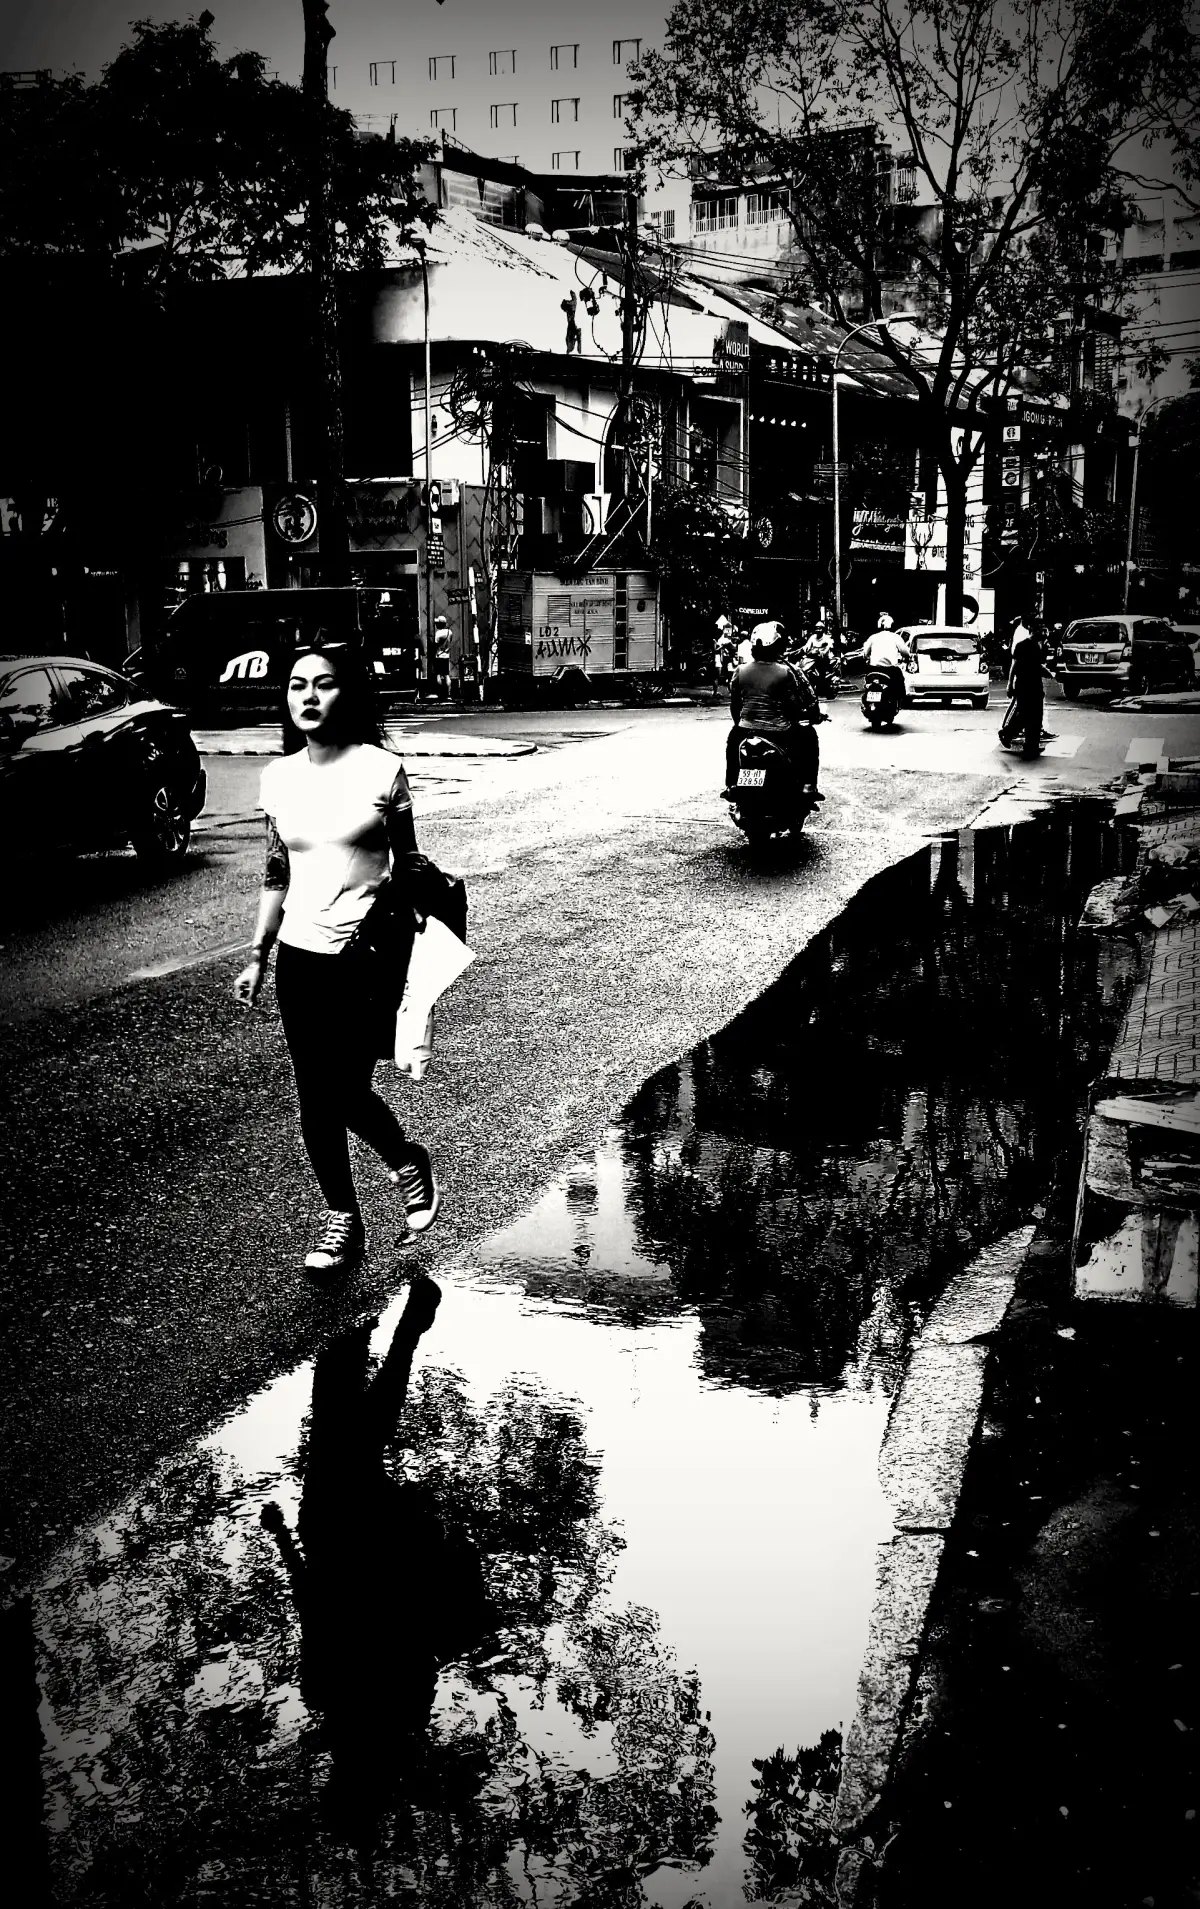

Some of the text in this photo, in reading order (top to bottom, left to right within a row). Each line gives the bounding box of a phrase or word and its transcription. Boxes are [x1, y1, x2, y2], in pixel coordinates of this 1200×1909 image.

[725, 339, 750, 357] WORLD
[1005, 518, 1015, 528] 2F
[738, 607, 769, 615] COMEBUY
